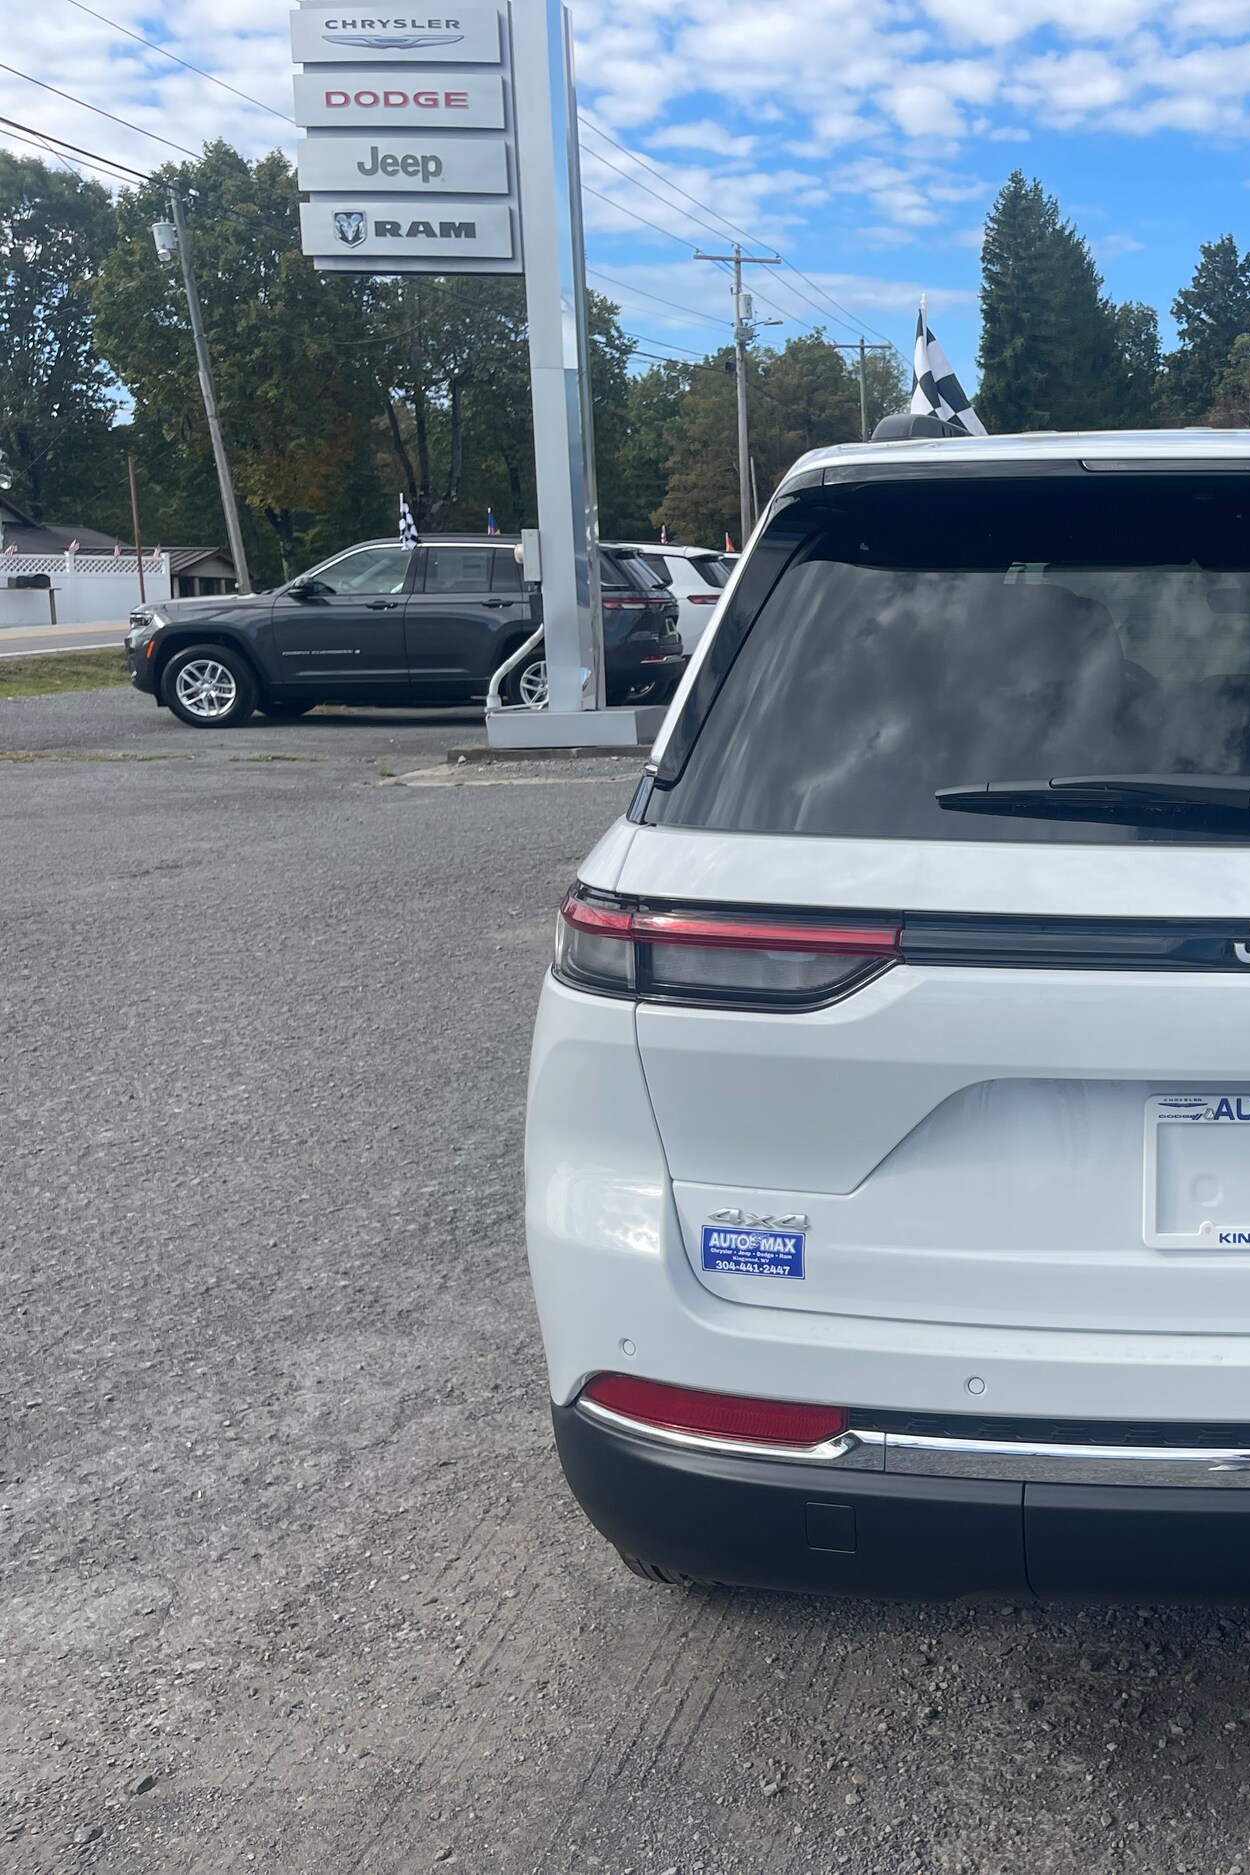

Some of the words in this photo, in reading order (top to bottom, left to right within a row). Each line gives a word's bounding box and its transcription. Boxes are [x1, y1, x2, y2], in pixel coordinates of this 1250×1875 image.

[324, 18, 461, 30] CHRYSLER
[325, 90, 470, 109] DODGE
[356, 146, 443, 183] Jeep
[374, 220, 477, 239] RAM
[709, 1232, 750, 1250] AUTO
[760, 1237, 797, 1254] MAX
[715, 1260, 790, 1275] 304-441-2447
